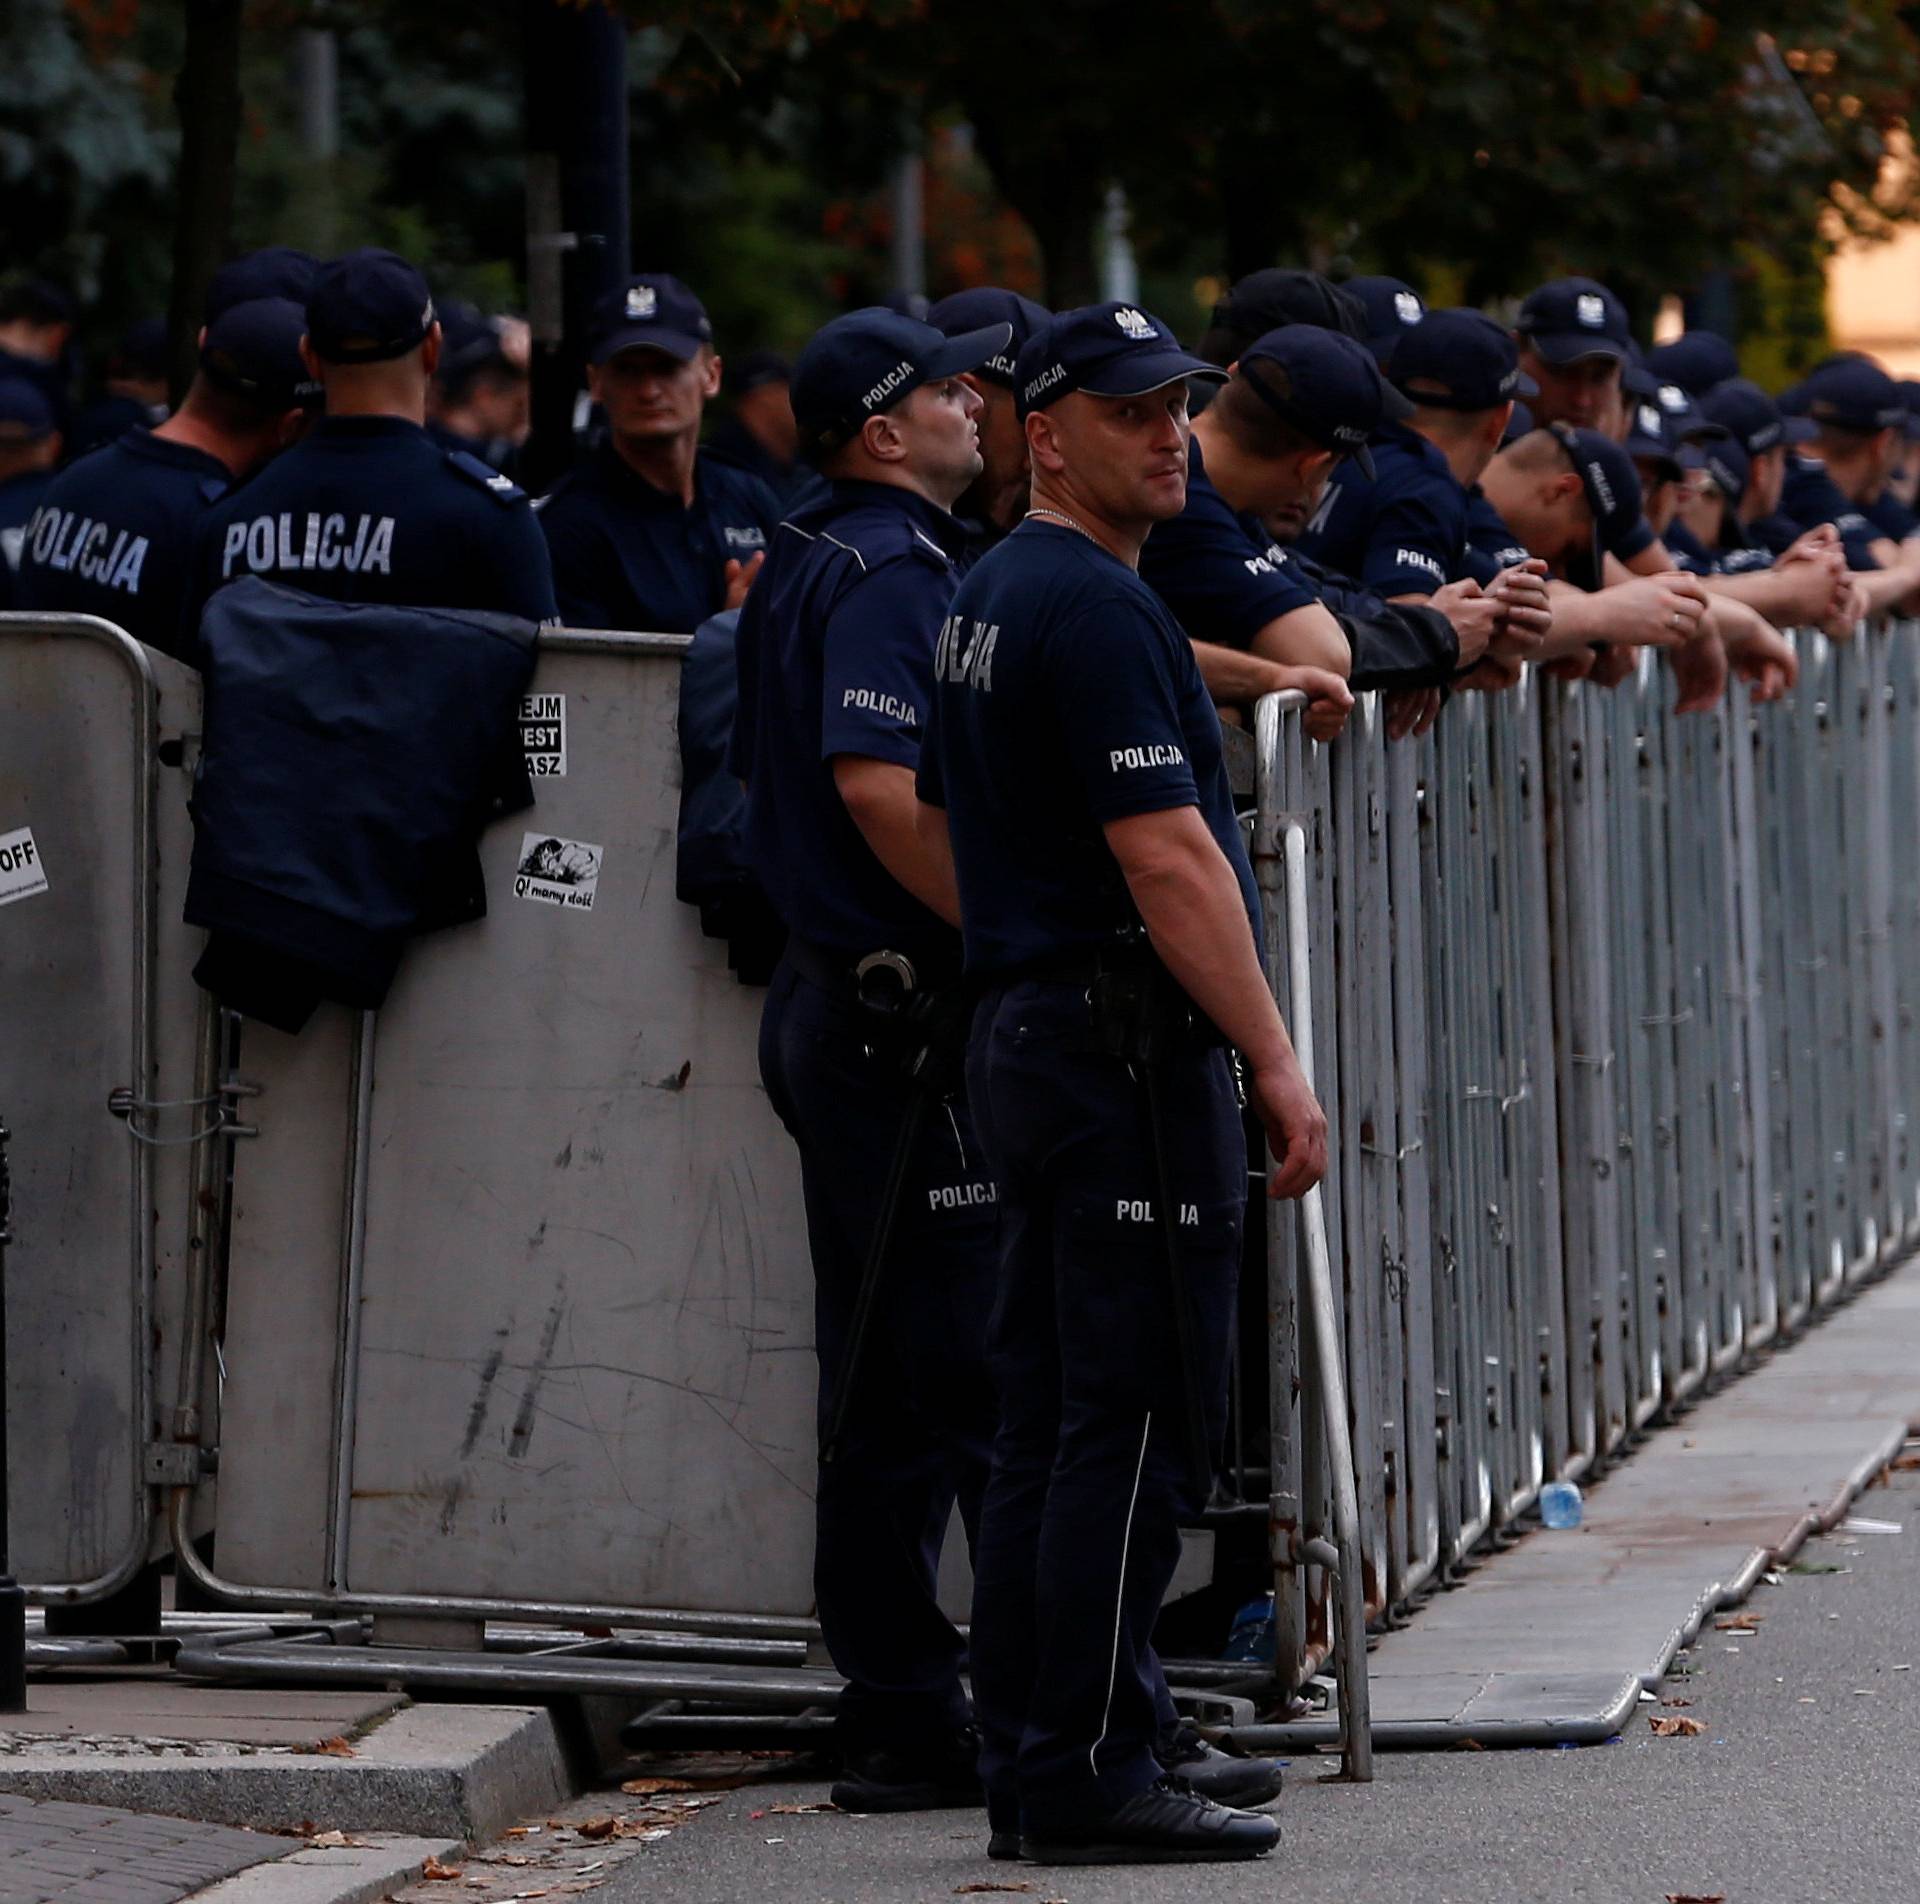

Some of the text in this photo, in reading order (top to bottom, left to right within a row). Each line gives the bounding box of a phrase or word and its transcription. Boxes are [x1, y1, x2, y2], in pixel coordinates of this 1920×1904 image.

[861, 361, 915, 410] POLICJA
[1024, 363, 1067, 403] POLICJA
[221, 512, 393, 579] POLICJA
[519, 697, 561, 719] EJM
[842, 688, 916, 726] POLICJA
[519, 726, 559, 748] EST
[526, 756, 561, 776] ASZ
[1109, 744, 1184, 773] POLICJA
[0, 843, 34, 872] OFF
[531, 887, 565, 905] mamy
[928, 1181, 1000, 1211] POLICJ
[1115, 1199, 1199, 1226] POLJA
